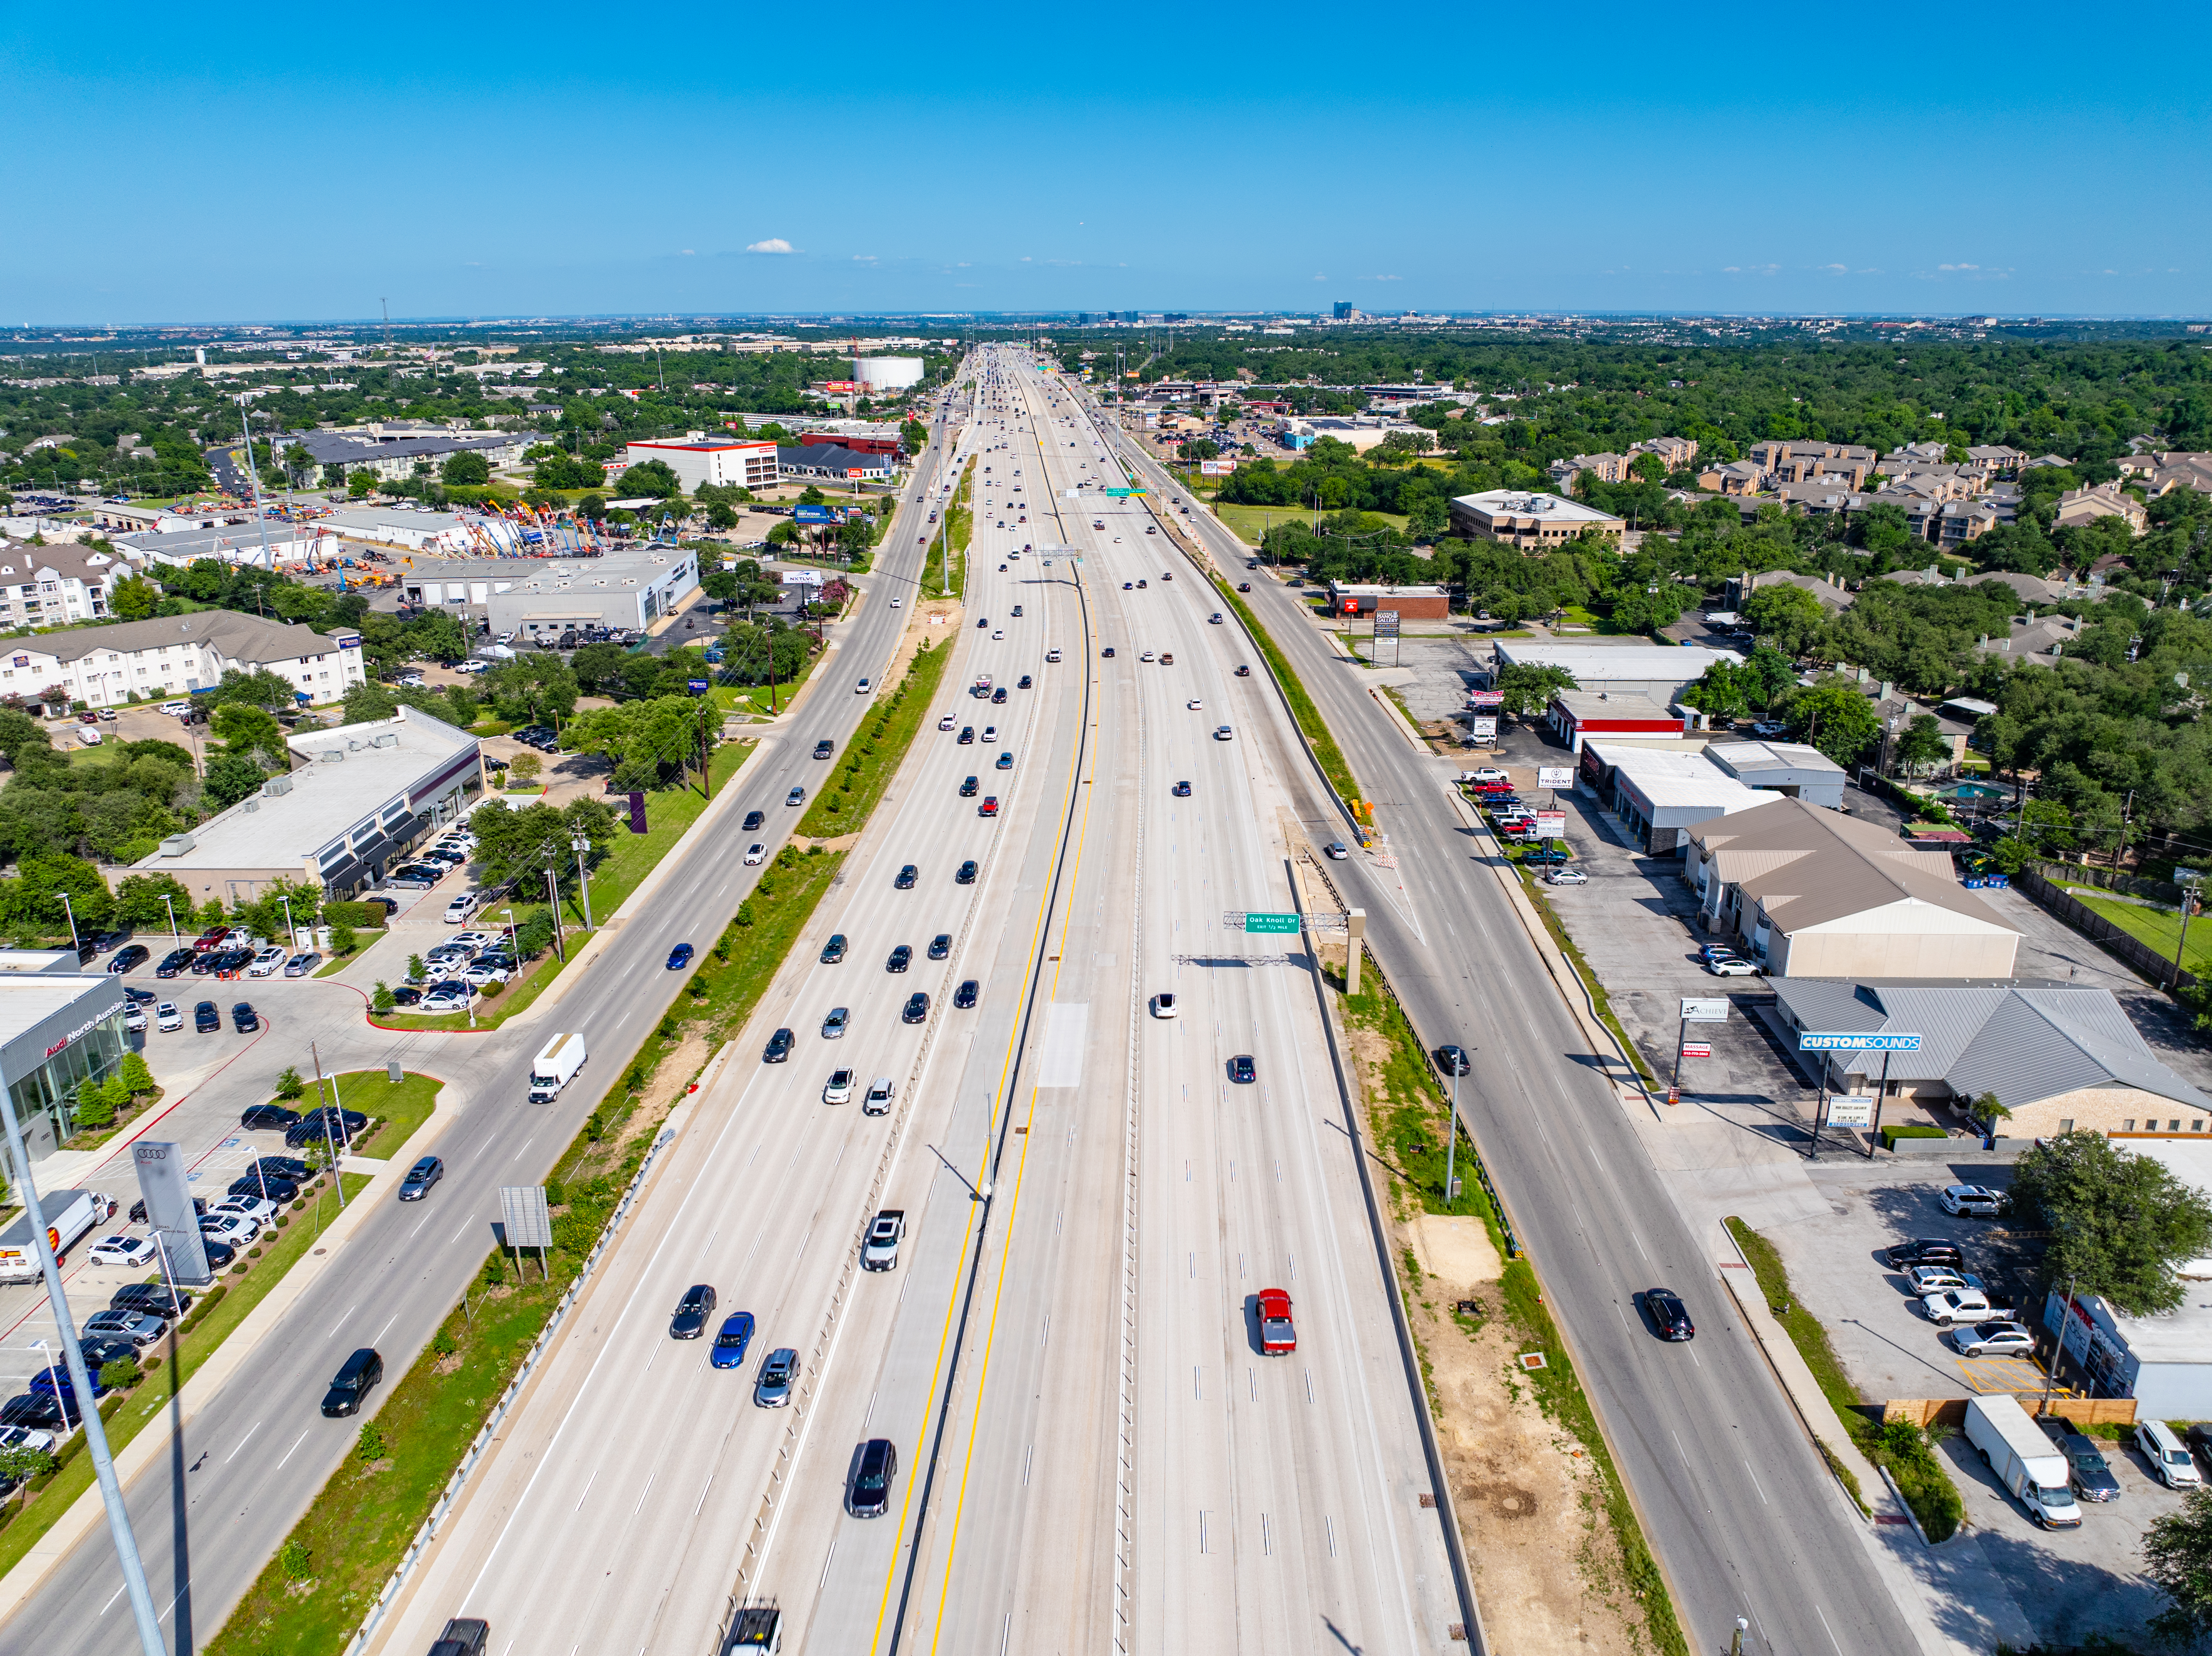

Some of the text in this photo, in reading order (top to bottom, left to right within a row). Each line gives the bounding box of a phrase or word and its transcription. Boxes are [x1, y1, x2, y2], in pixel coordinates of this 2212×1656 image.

[44, 1001, 124, 1058] Audi North Austin
[1974, 1125, 1984, 1134] FOOT
[2066, 1321, 2086, 1346] AUDIO
